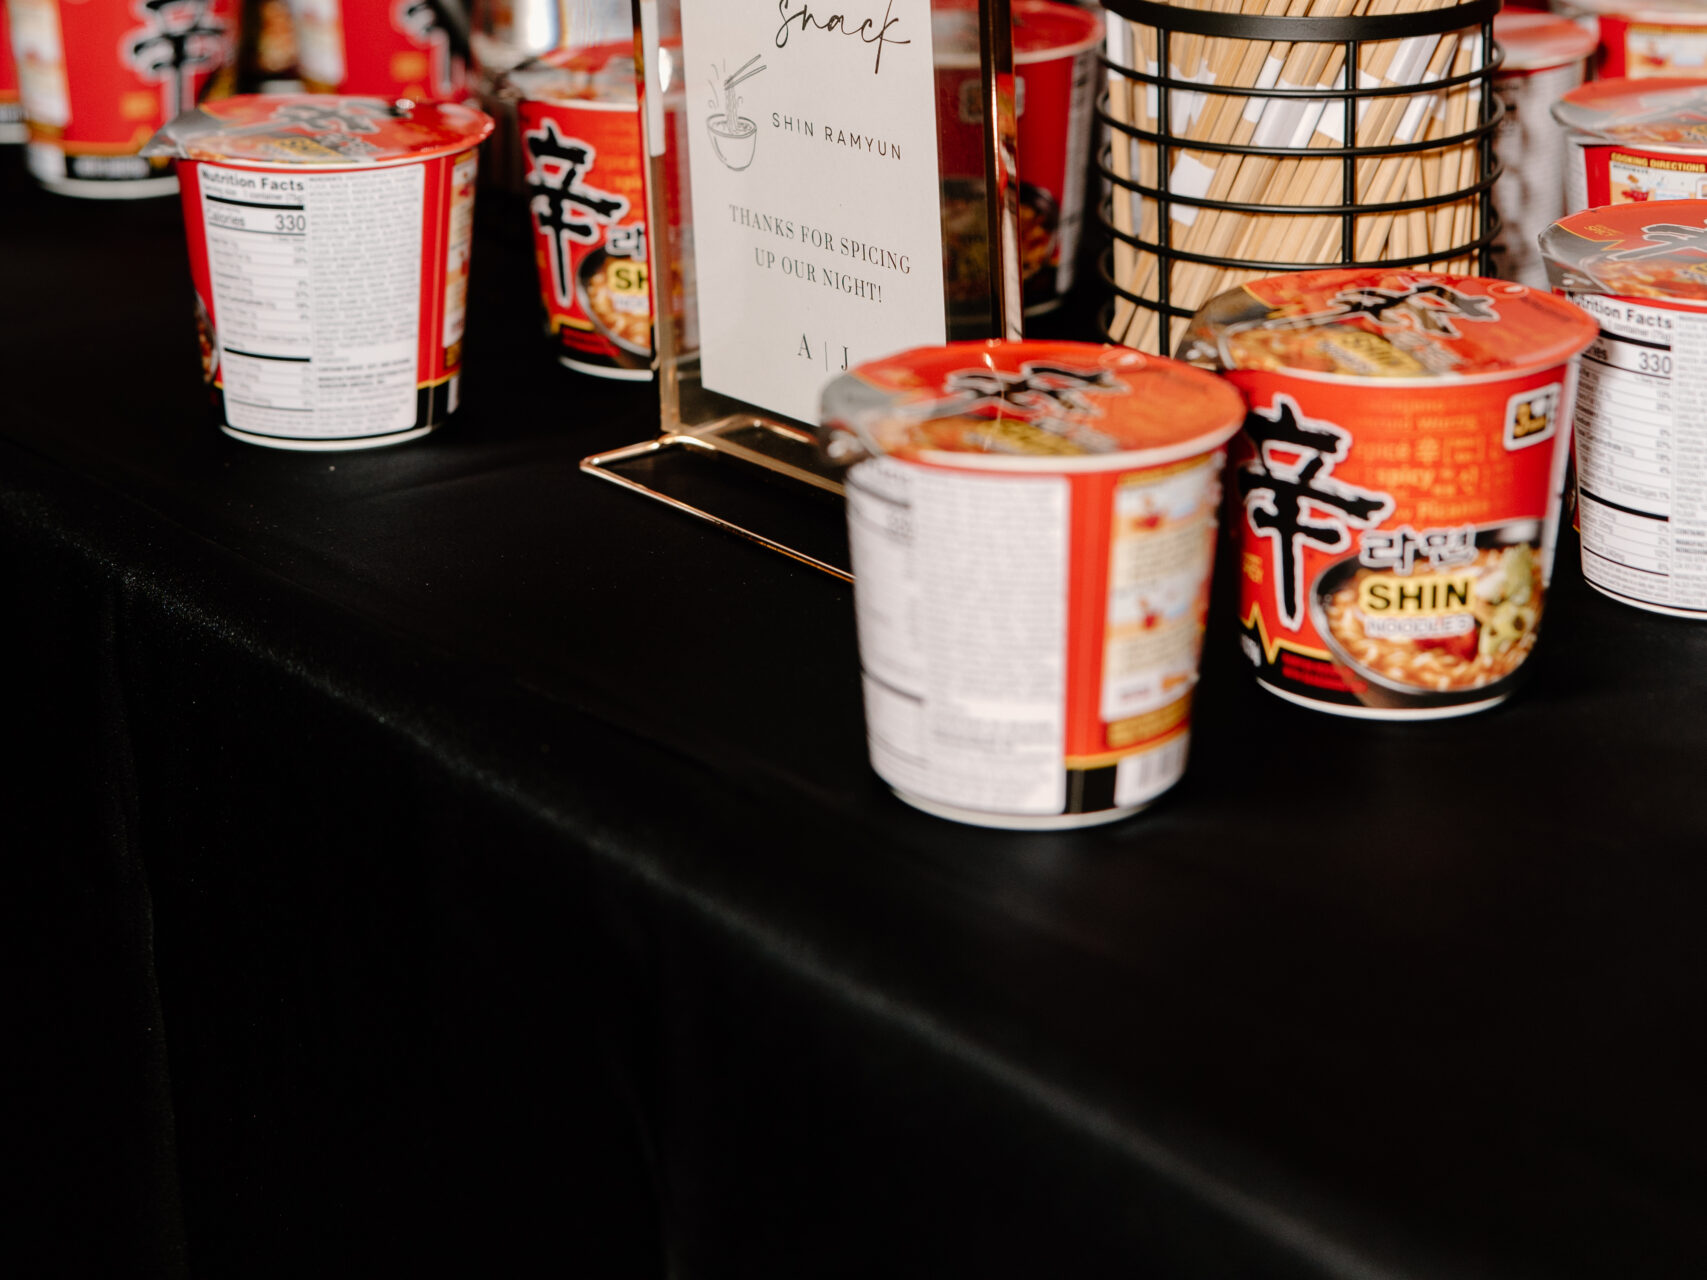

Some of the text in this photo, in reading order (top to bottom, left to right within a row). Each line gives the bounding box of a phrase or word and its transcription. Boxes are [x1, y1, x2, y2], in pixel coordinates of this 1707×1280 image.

[772, 112, 901, 160] SHIN RAMYUN
[201, 169, 305, 191] Nutrition Facts
[275, 214, 307, 232] 330
[729, 204, 911, 275] THANKS FOR SPICING
[754, 247, 882, 303] UP OUR NIGHT!
[1627, 308, 1672, 329] Facts
[797, 333, 813, 360] A
[1638, 352, 1672, 375] 330
[1240, 403, 1385, 620] 辛
[1361, 525, 1478, 576] 라면
[1368, 581, 1469, 610] SHIN
